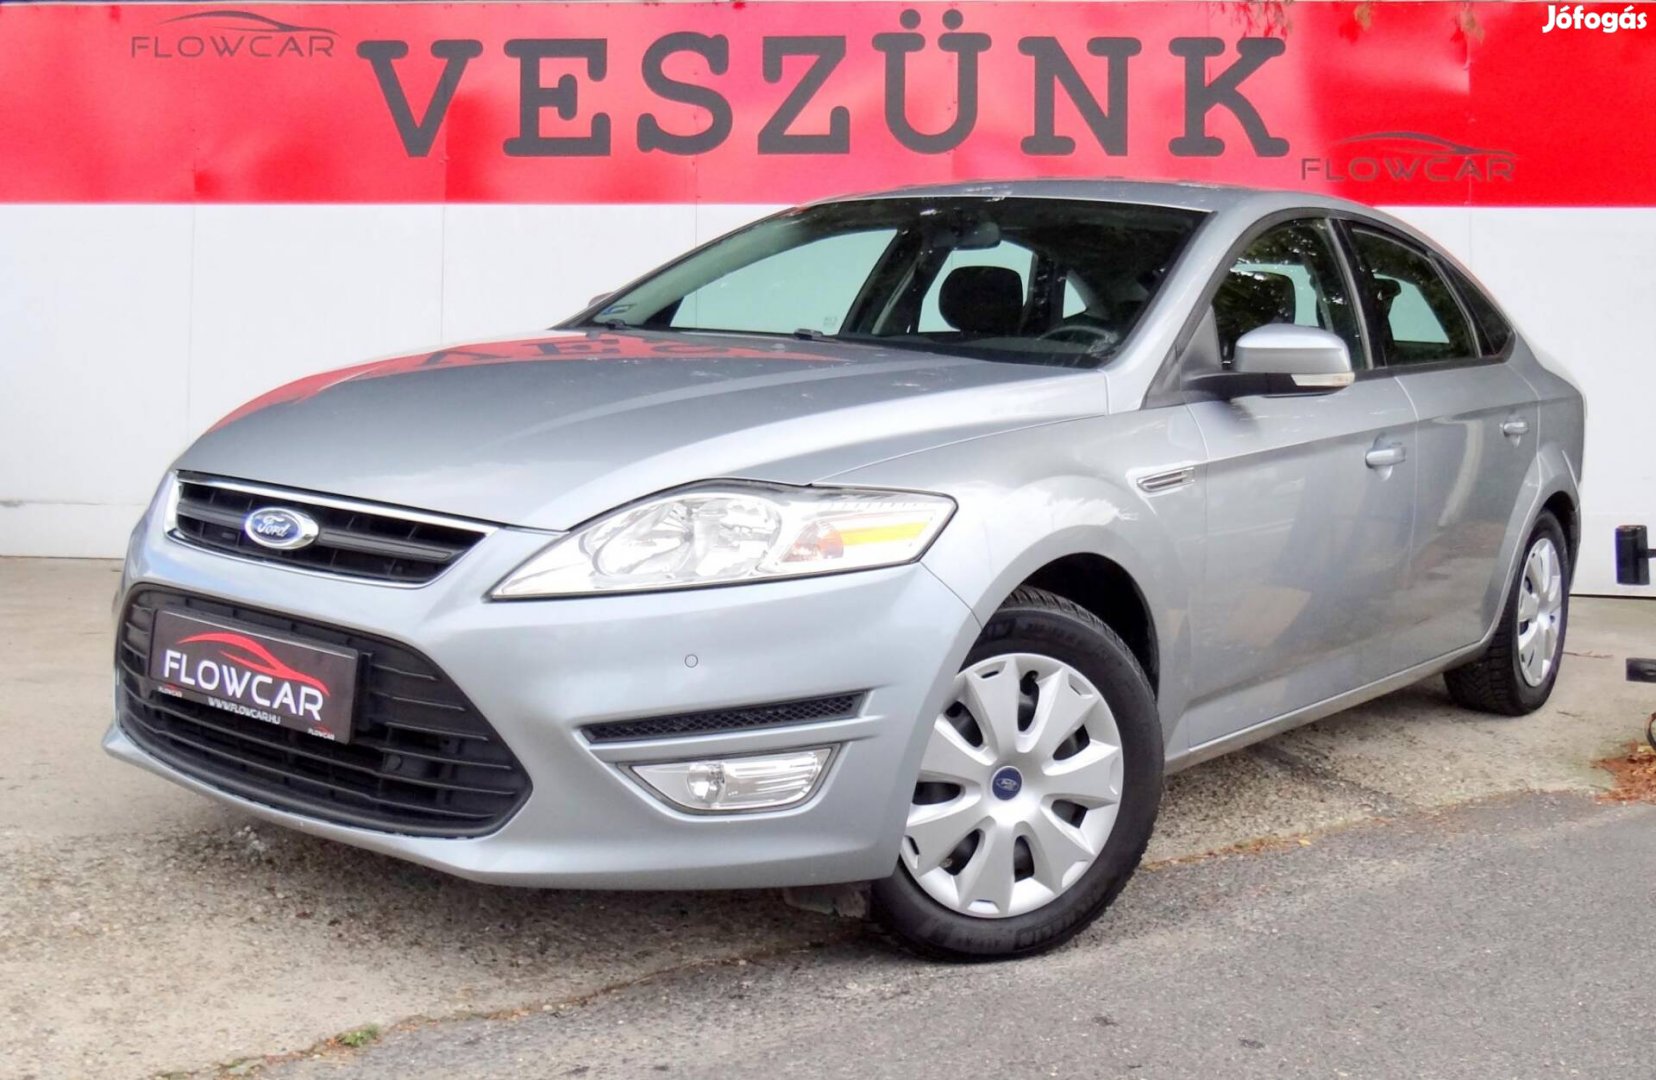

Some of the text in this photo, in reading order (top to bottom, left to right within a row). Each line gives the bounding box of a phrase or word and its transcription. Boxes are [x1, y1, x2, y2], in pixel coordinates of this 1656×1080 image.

[131, 36, 334, 58] FLOWCAR
[356, 9, 1289, 157] VESZÜNK
[1301, 157, 1516, 182] FLOWCAR
[257, 515, 291, 538] Ford
[163, 649, 324, 721] FLOWCAR
